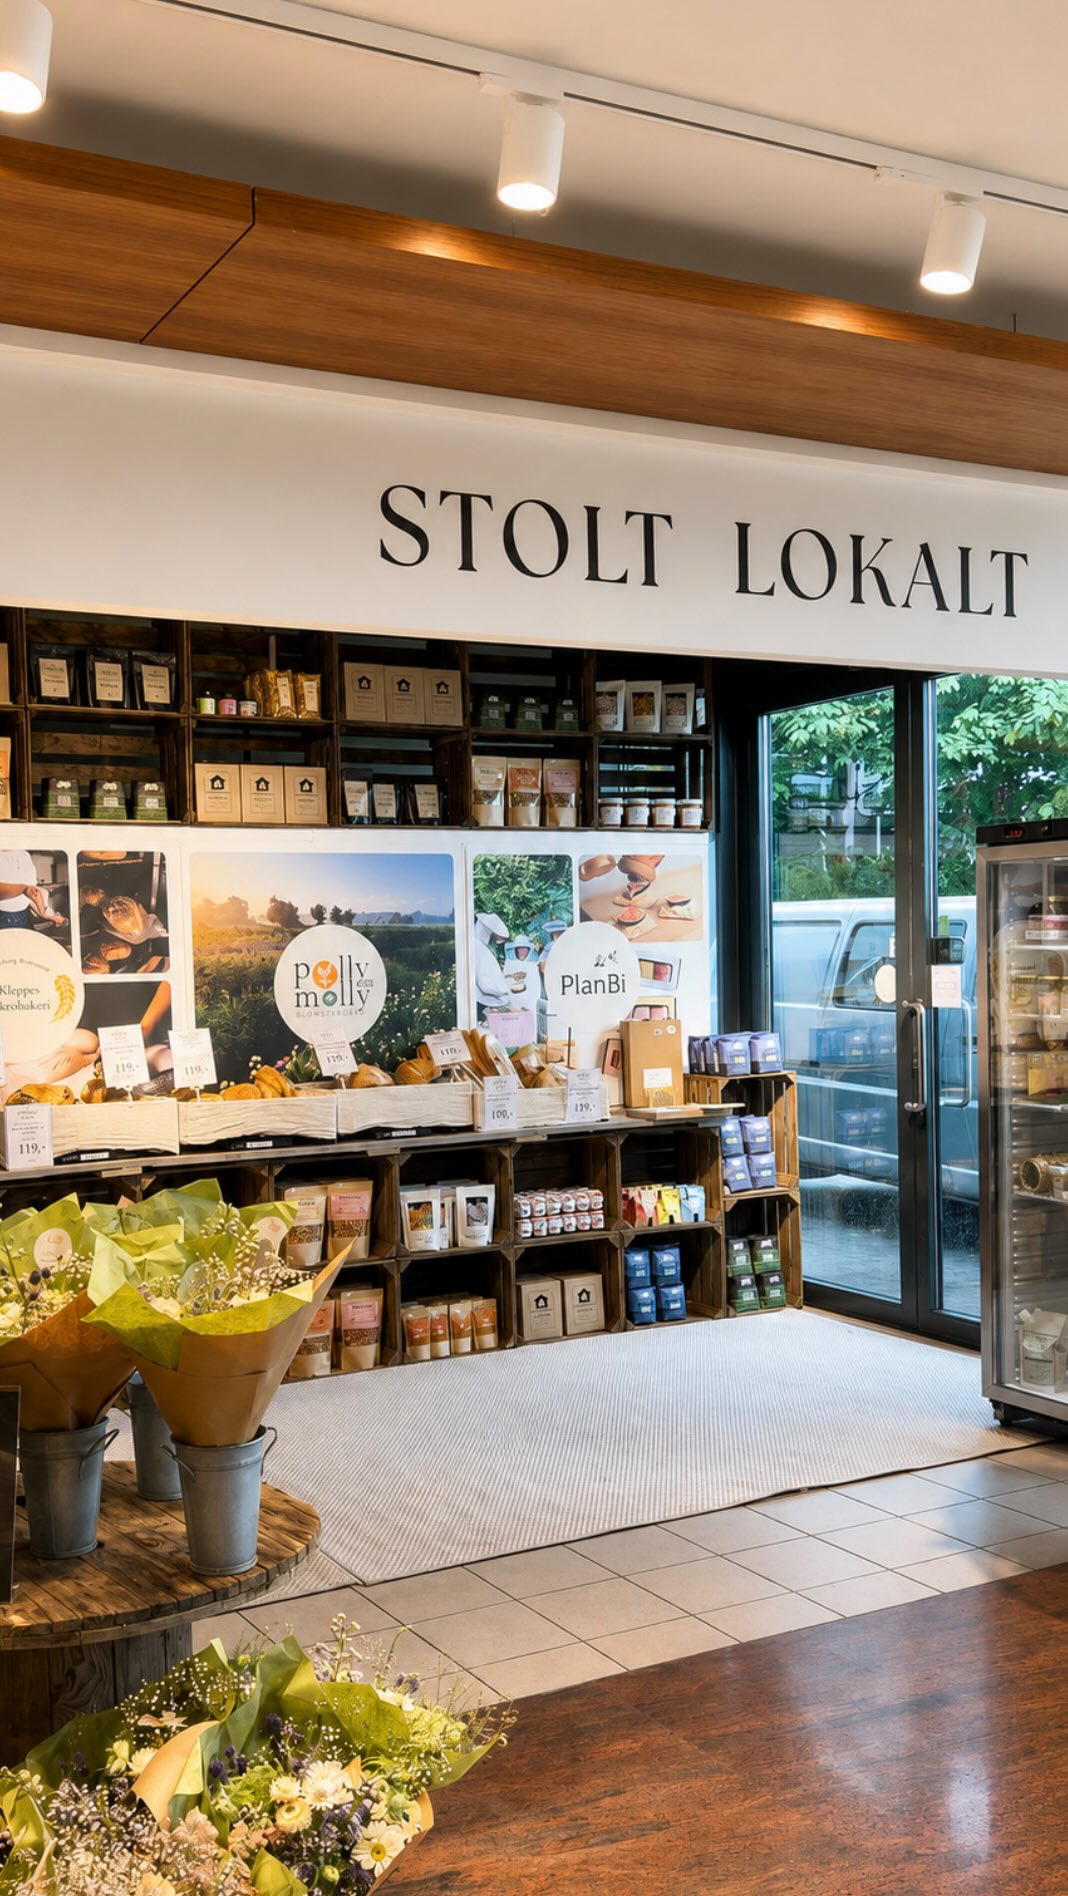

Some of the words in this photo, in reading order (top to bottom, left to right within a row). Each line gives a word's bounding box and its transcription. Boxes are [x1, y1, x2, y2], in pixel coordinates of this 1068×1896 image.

[380, 484, 673, 587] STOLT
[735, 522, 1028, 618] LOKALT
[294, 954, 369, 989] polly
[561, 973, 625, 995] PlanBi
[0, 985, 40, 998] Kleppes
[295, 980, 370, 1012] molly
